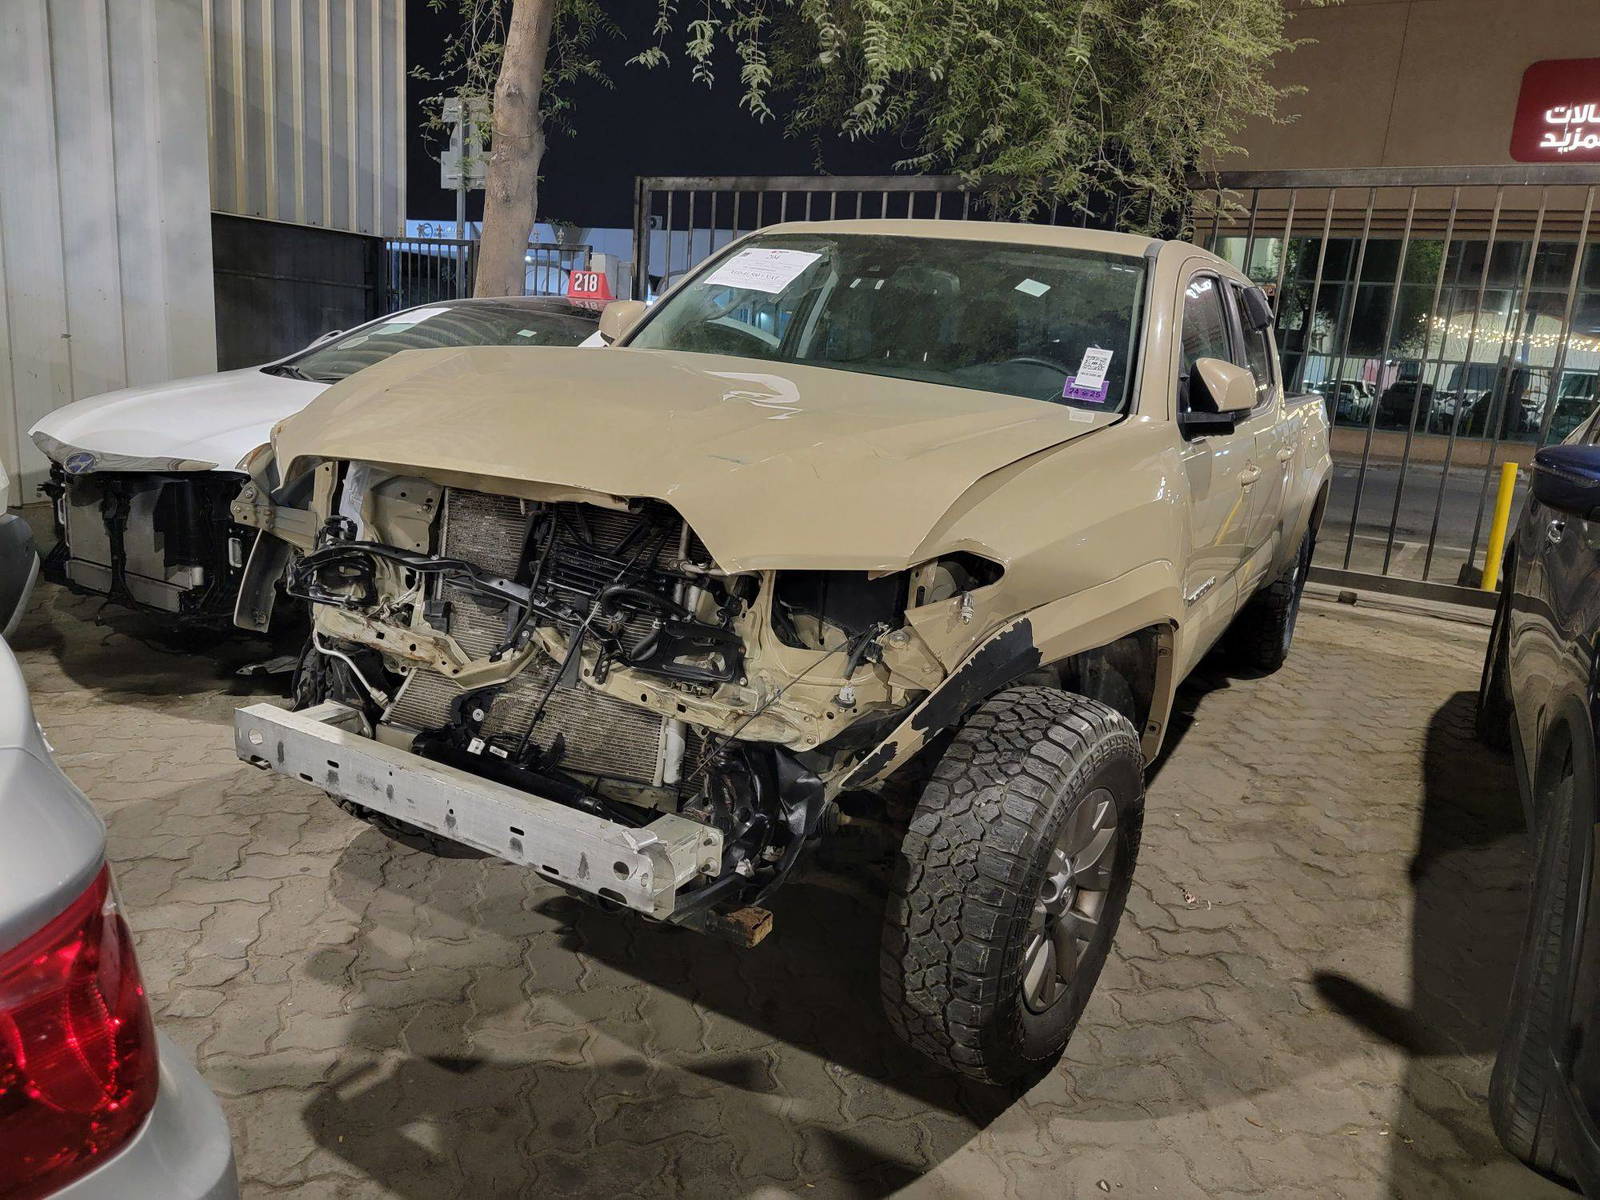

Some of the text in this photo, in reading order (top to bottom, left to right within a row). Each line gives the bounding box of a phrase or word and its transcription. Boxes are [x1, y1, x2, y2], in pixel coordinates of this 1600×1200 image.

[1545, 104, 1600, 124] الات
[1540, 128, 1600, 152] مزيد
[574, 273, 598, 292] 218
